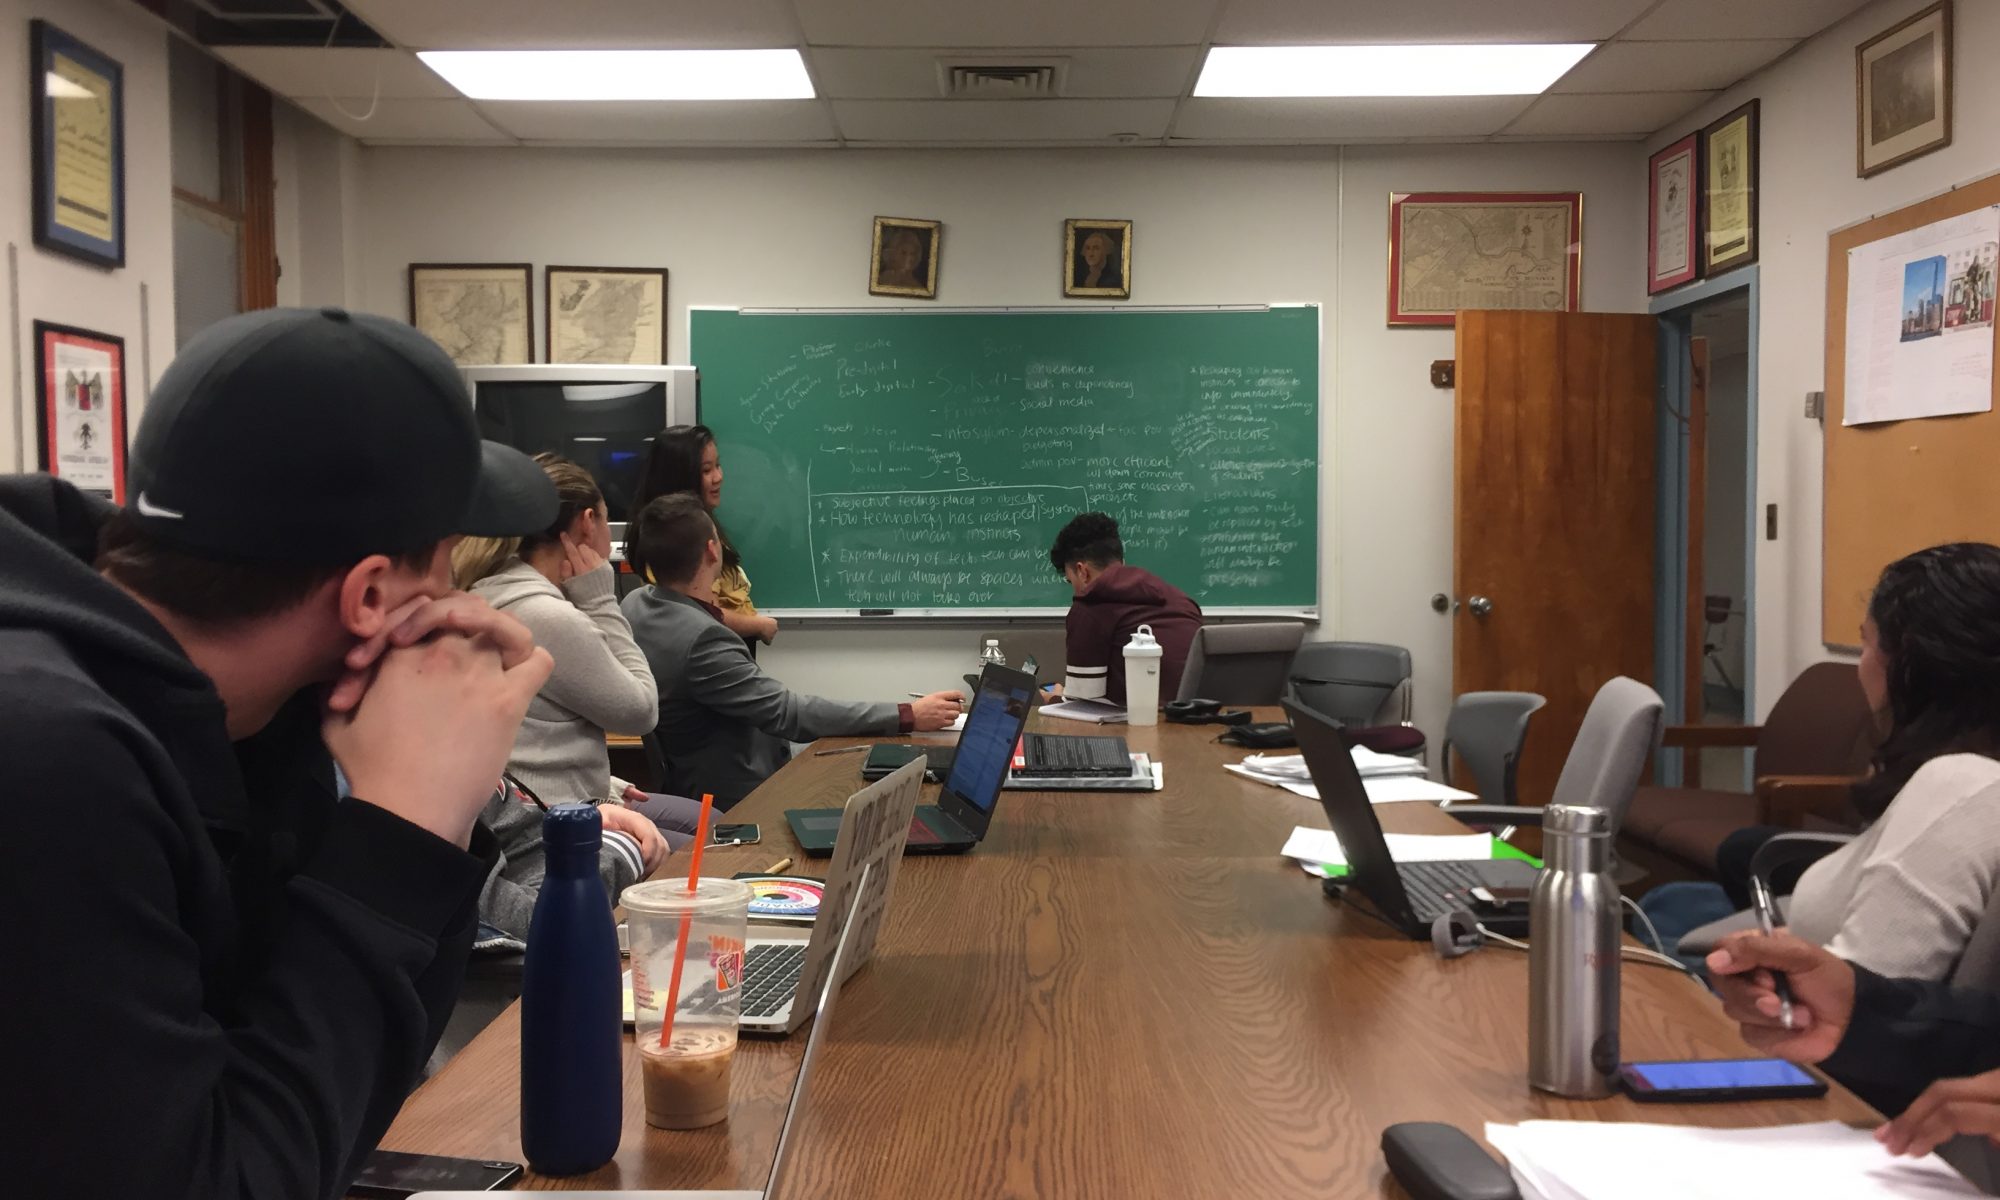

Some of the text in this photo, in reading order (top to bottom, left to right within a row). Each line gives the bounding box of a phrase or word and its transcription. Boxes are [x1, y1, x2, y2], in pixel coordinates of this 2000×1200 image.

[1059, 396, 1096, 407] media
[1087, 456, 1120, 467] more
[830, 504, 1036, 530] How technology has reshaped
[924, 551, 939, 565] of
[1008, 550, 1030, 560] can
[837, 569, 874, 584] There
[880, 569, 901, 585] will
[908, 570, 951, 591] always
[958, 571, 971, 584] be
[980, 571, 1023, 586] spaces
[875, 588, 896, 601] will
[901, 589, 921, 601] not
